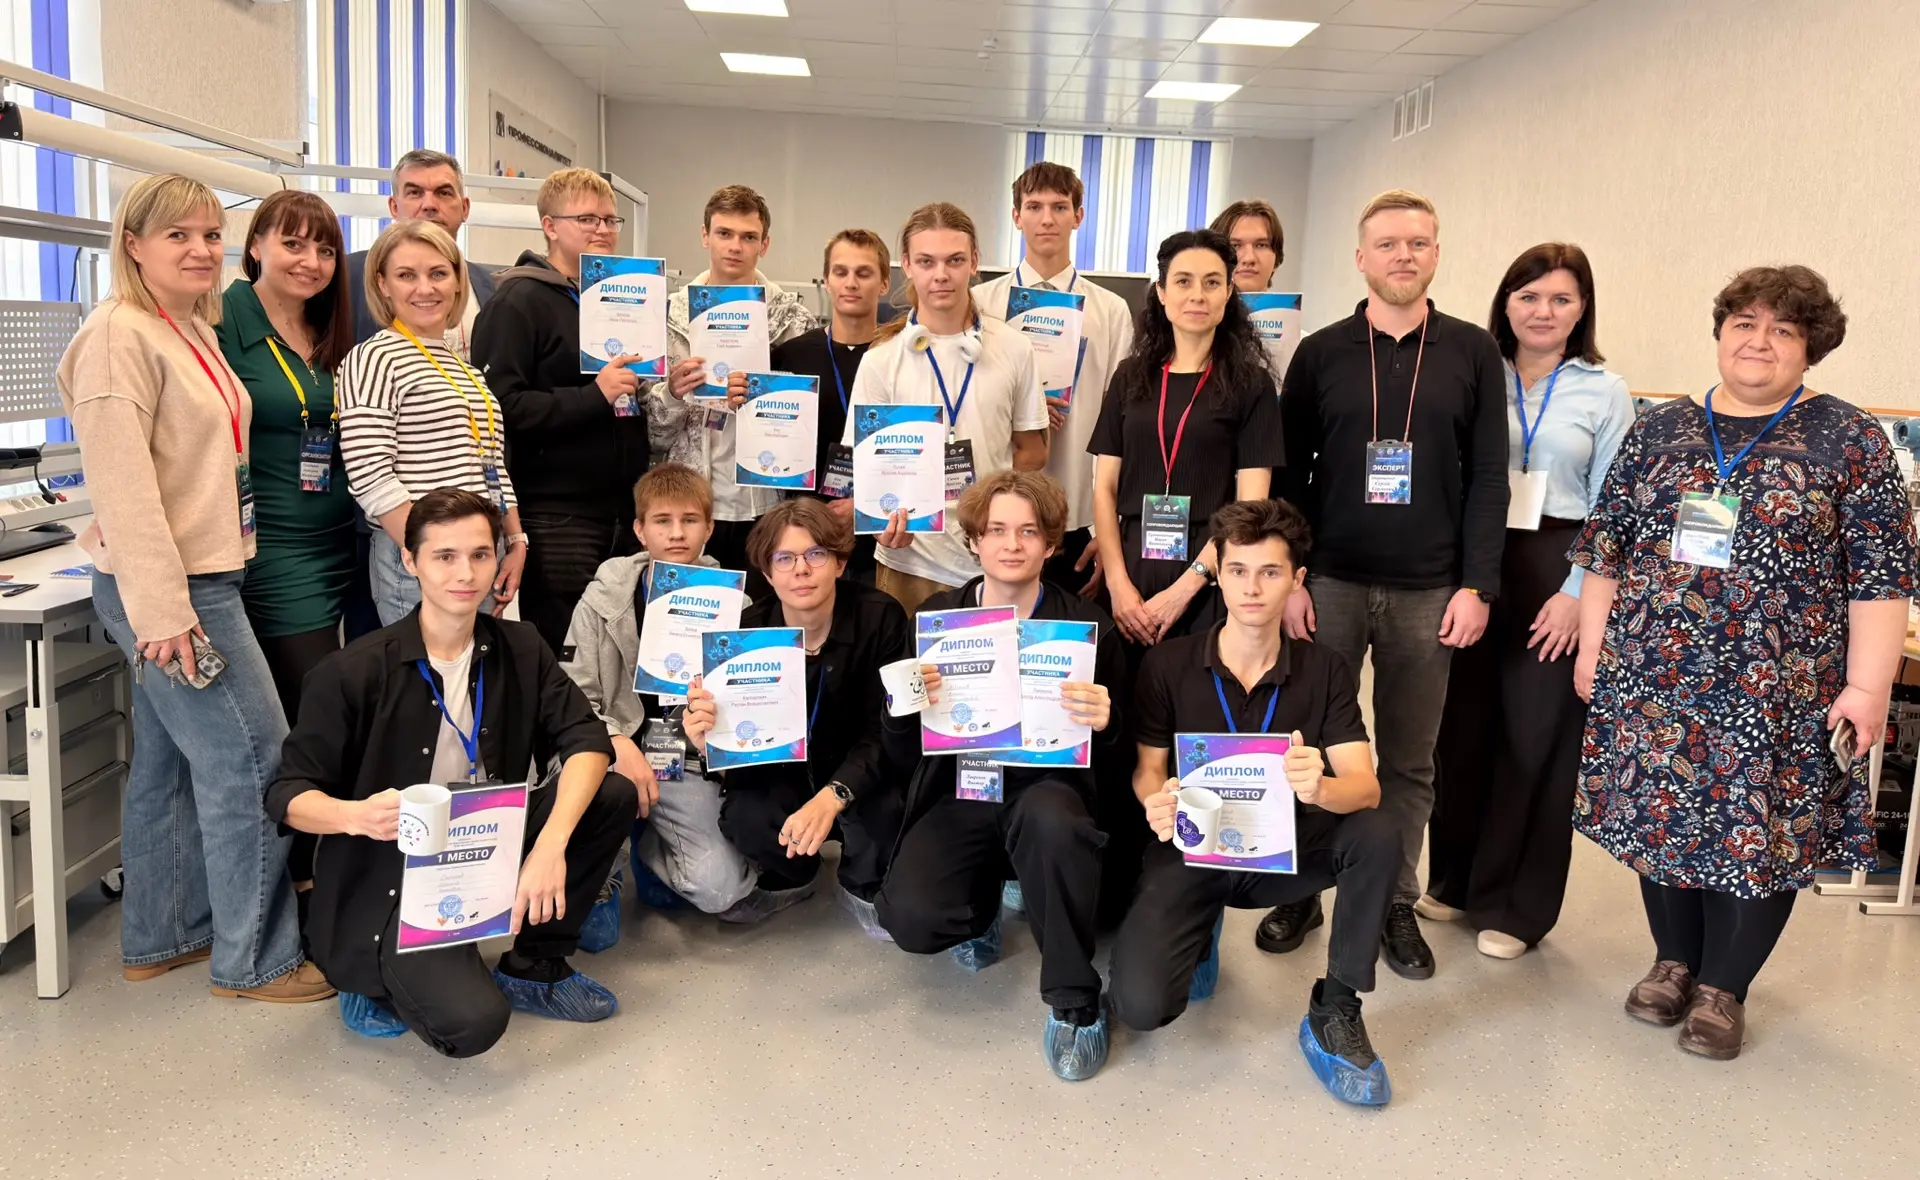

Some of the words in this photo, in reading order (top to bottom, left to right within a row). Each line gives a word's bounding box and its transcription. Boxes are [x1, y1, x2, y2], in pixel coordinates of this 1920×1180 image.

[600, 284, 647, 294] ДИПЛОМ
[707, 312, 749, 321] ДИПЛОМ
[1023, 314, 1064, 327] ДИПЛОМ
[1256, 320, 1283, 329] ПЛОМ
[755, 400, 799, 411] ДИПЛОМ
[874, 435, 924, 445] ДИПЛОМ
[945, 462, 971, 471] АСТНИК
[1372, 464, 1406, 472] ЭКСПЕРТ
[669, 595, 720, 609] ДИПЛОМ
[677, 609, 709, 618] УЧАСТНИКА
[940, 638, 994, 652] ДИПЛОМ
[1019, 653, 1072, 666] ДИПЛОМ
[726, 662, 781, 675] ДИПЛОМ
[944, 665, 949, 674] 1
[953, 663, 990, 673] МЕСТО
[1204, 766, 1265, 777] ДИПЛОМ
[1219, 789, 1260, 799] МЕСТО
[447, 823, 498, 837] ИПЛОМ
[437, 854, 443, 863] 1
[447, 849, 490, 862] МЕСТО
